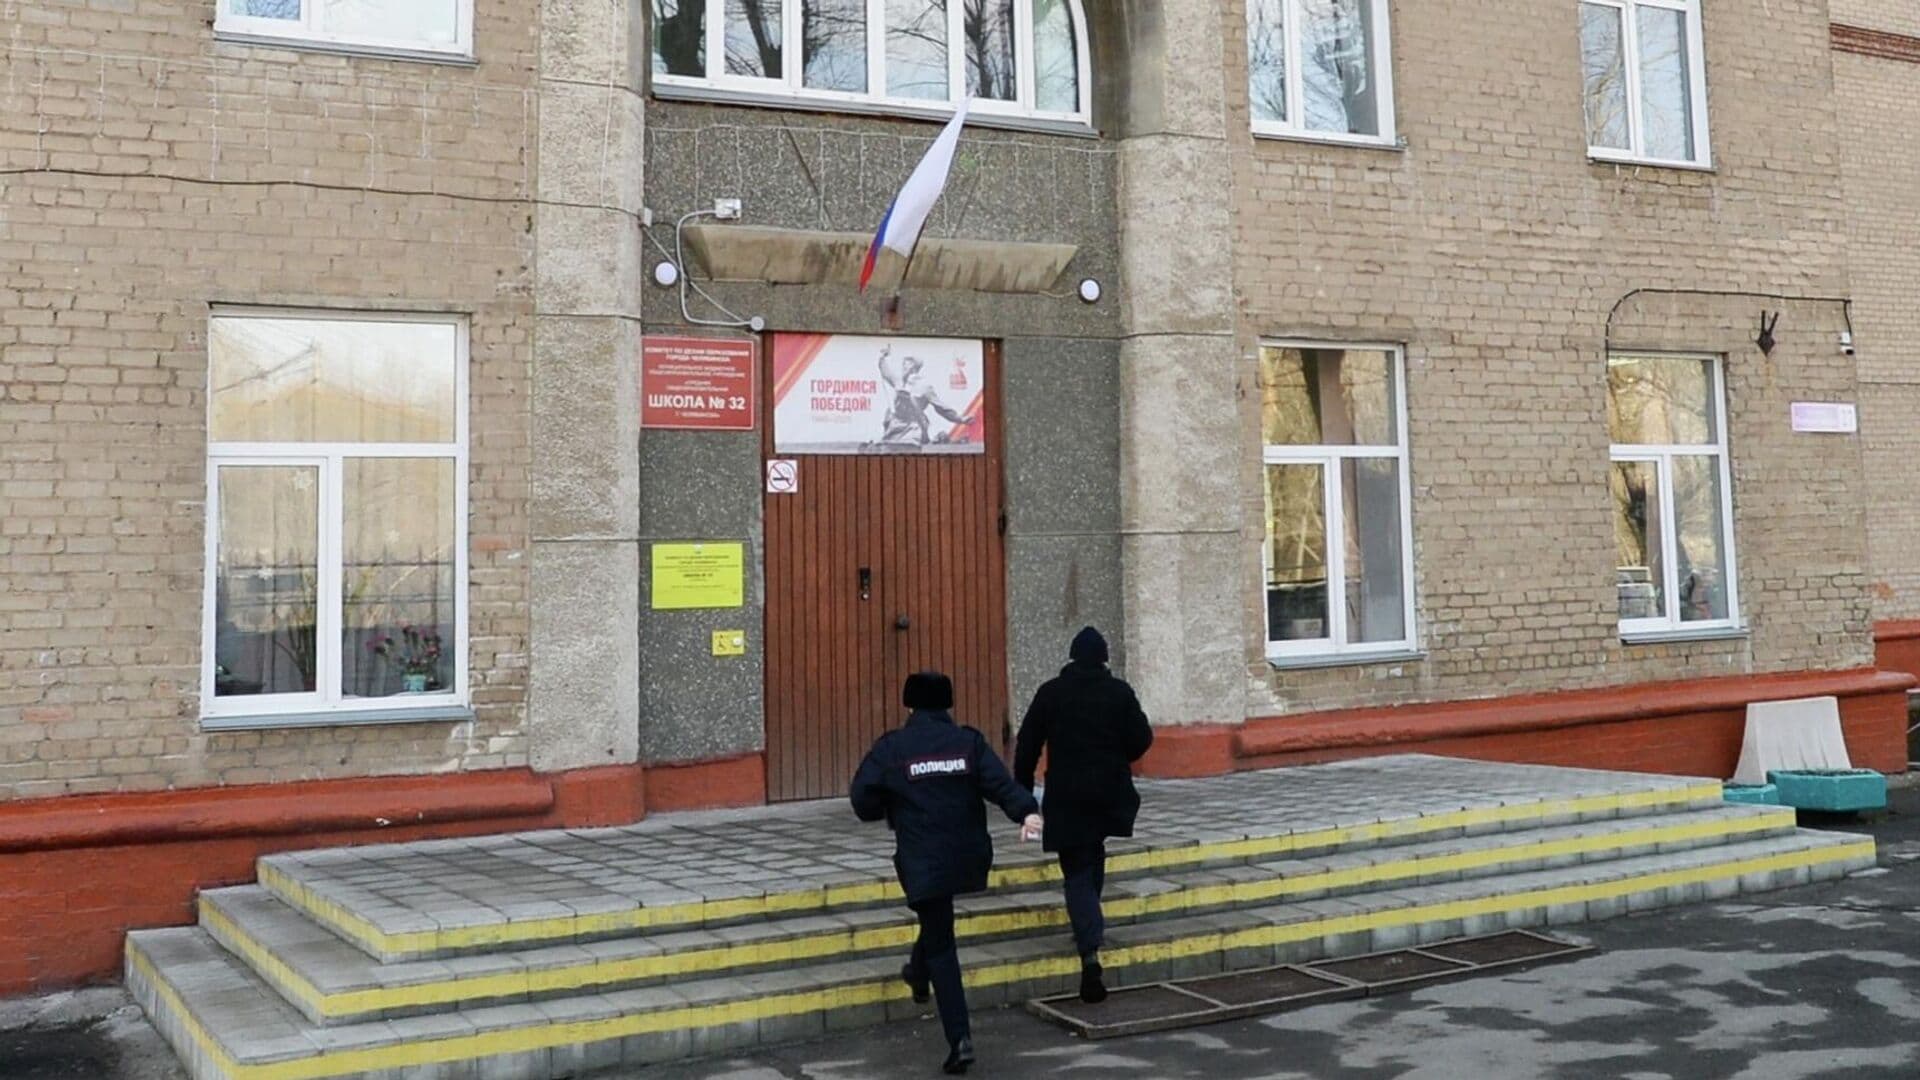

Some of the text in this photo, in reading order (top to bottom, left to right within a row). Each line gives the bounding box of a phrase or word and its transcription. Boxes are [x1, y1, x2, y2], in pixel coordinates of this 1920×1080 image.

[811, 379, 877, 395] ГОРДИМСЯ
[648, 394, 746, 410] ШКОЛА № 32
[811, 396, 871, 412] ПОБЕДОЙ!
[910, 758, 966, 776] ПОЛИЦИЯ
